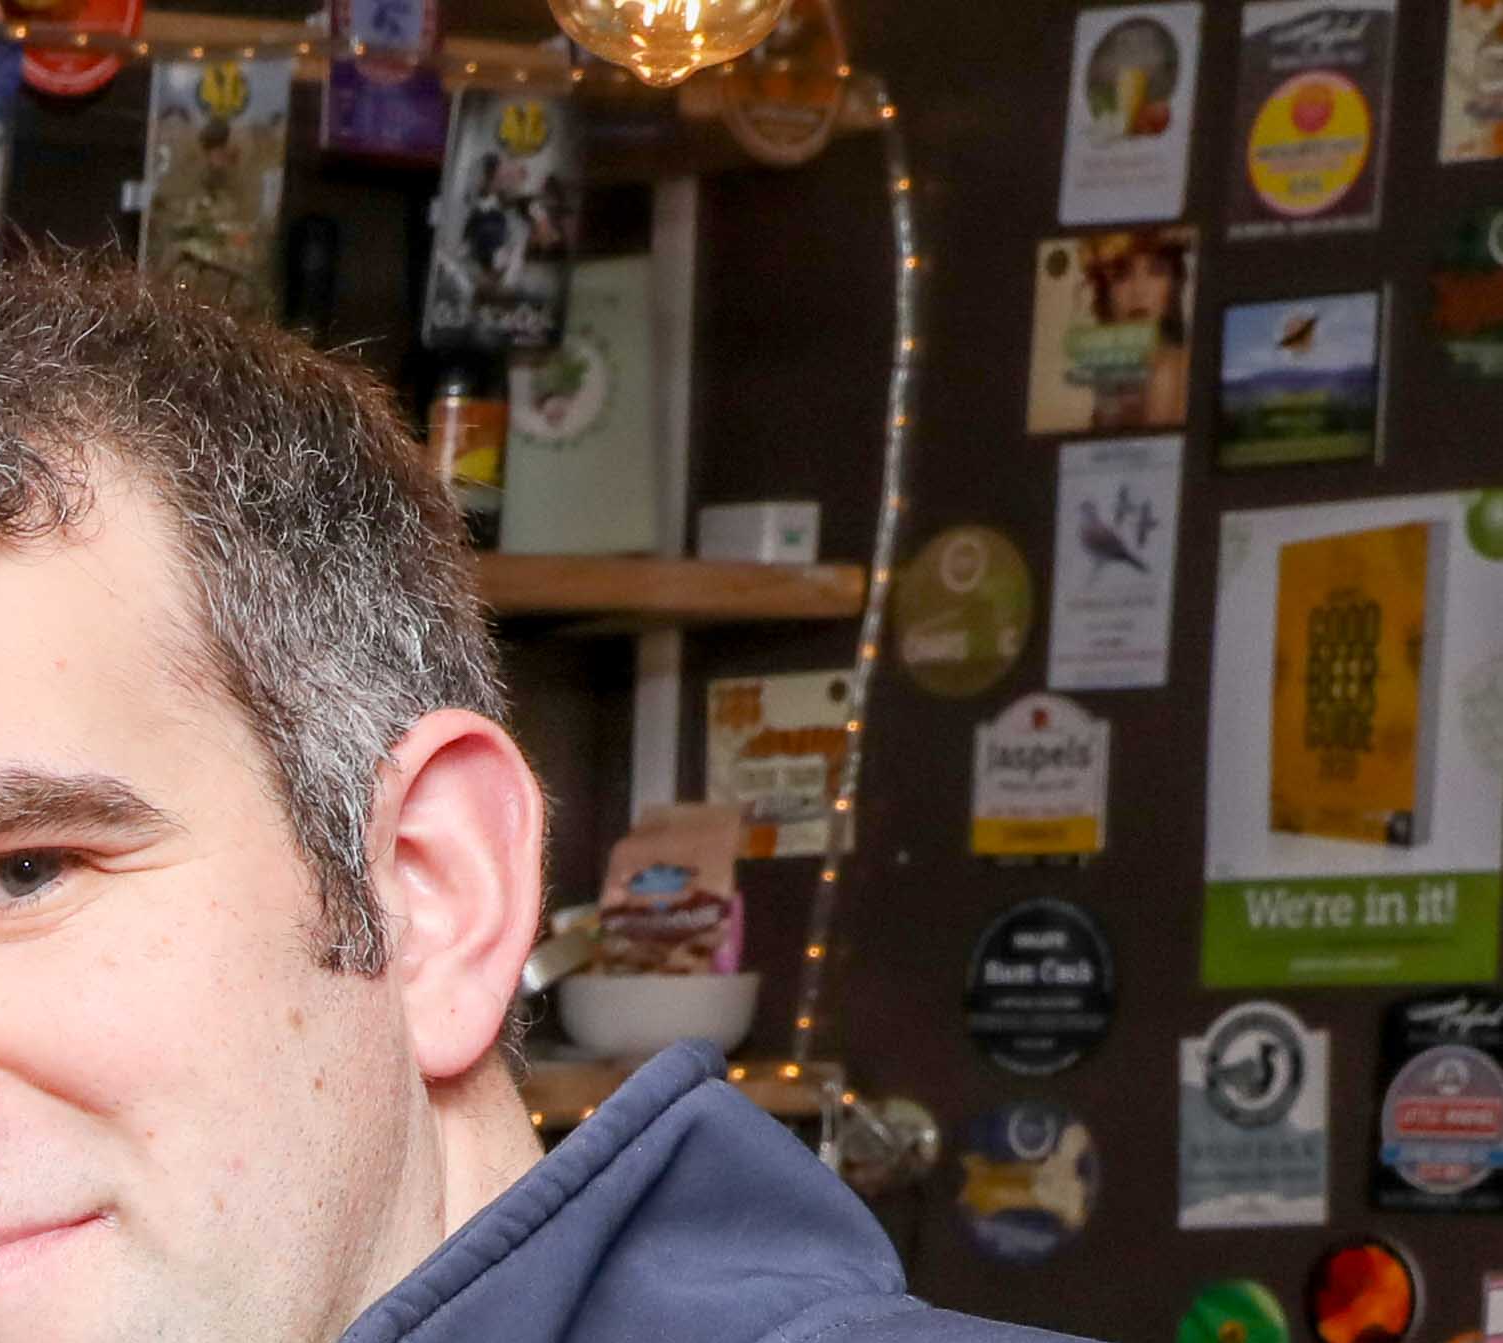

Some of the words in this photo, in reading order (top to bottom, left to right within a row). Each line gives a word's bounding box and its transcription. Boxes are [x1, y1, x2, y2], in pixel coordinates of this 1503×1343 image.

[1243, 887, 1354, 929] We're
[1364, 884, 1407, 927] in
[1416, 880, 1458, 926] it!
